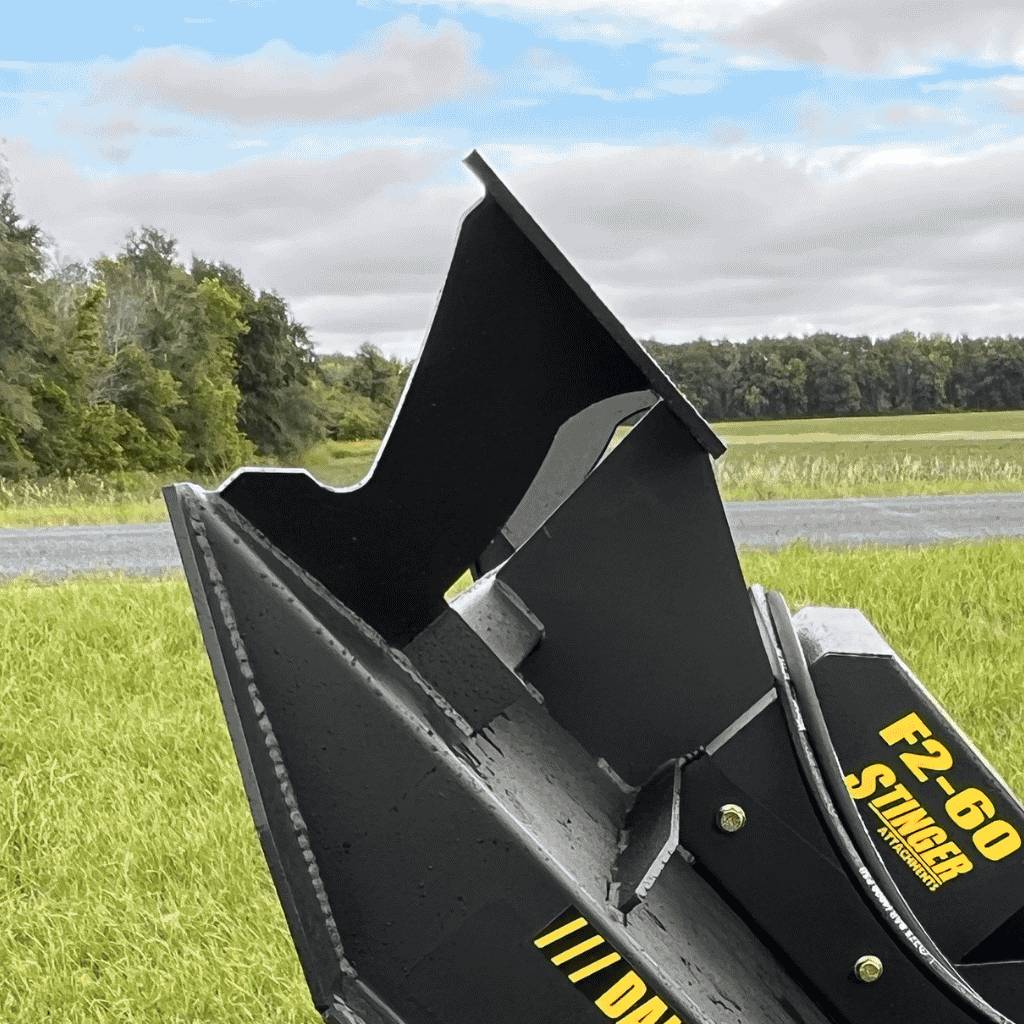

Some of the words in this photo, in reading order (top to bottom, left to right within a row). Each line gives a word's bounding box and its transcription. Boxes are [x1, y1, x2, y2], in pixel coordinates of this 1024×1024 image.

[844, 763, 974, 884] STINGER
[879, 712, 1022, 861] F2-60
[877, 826, 940, 891] ATTACHMENTS
